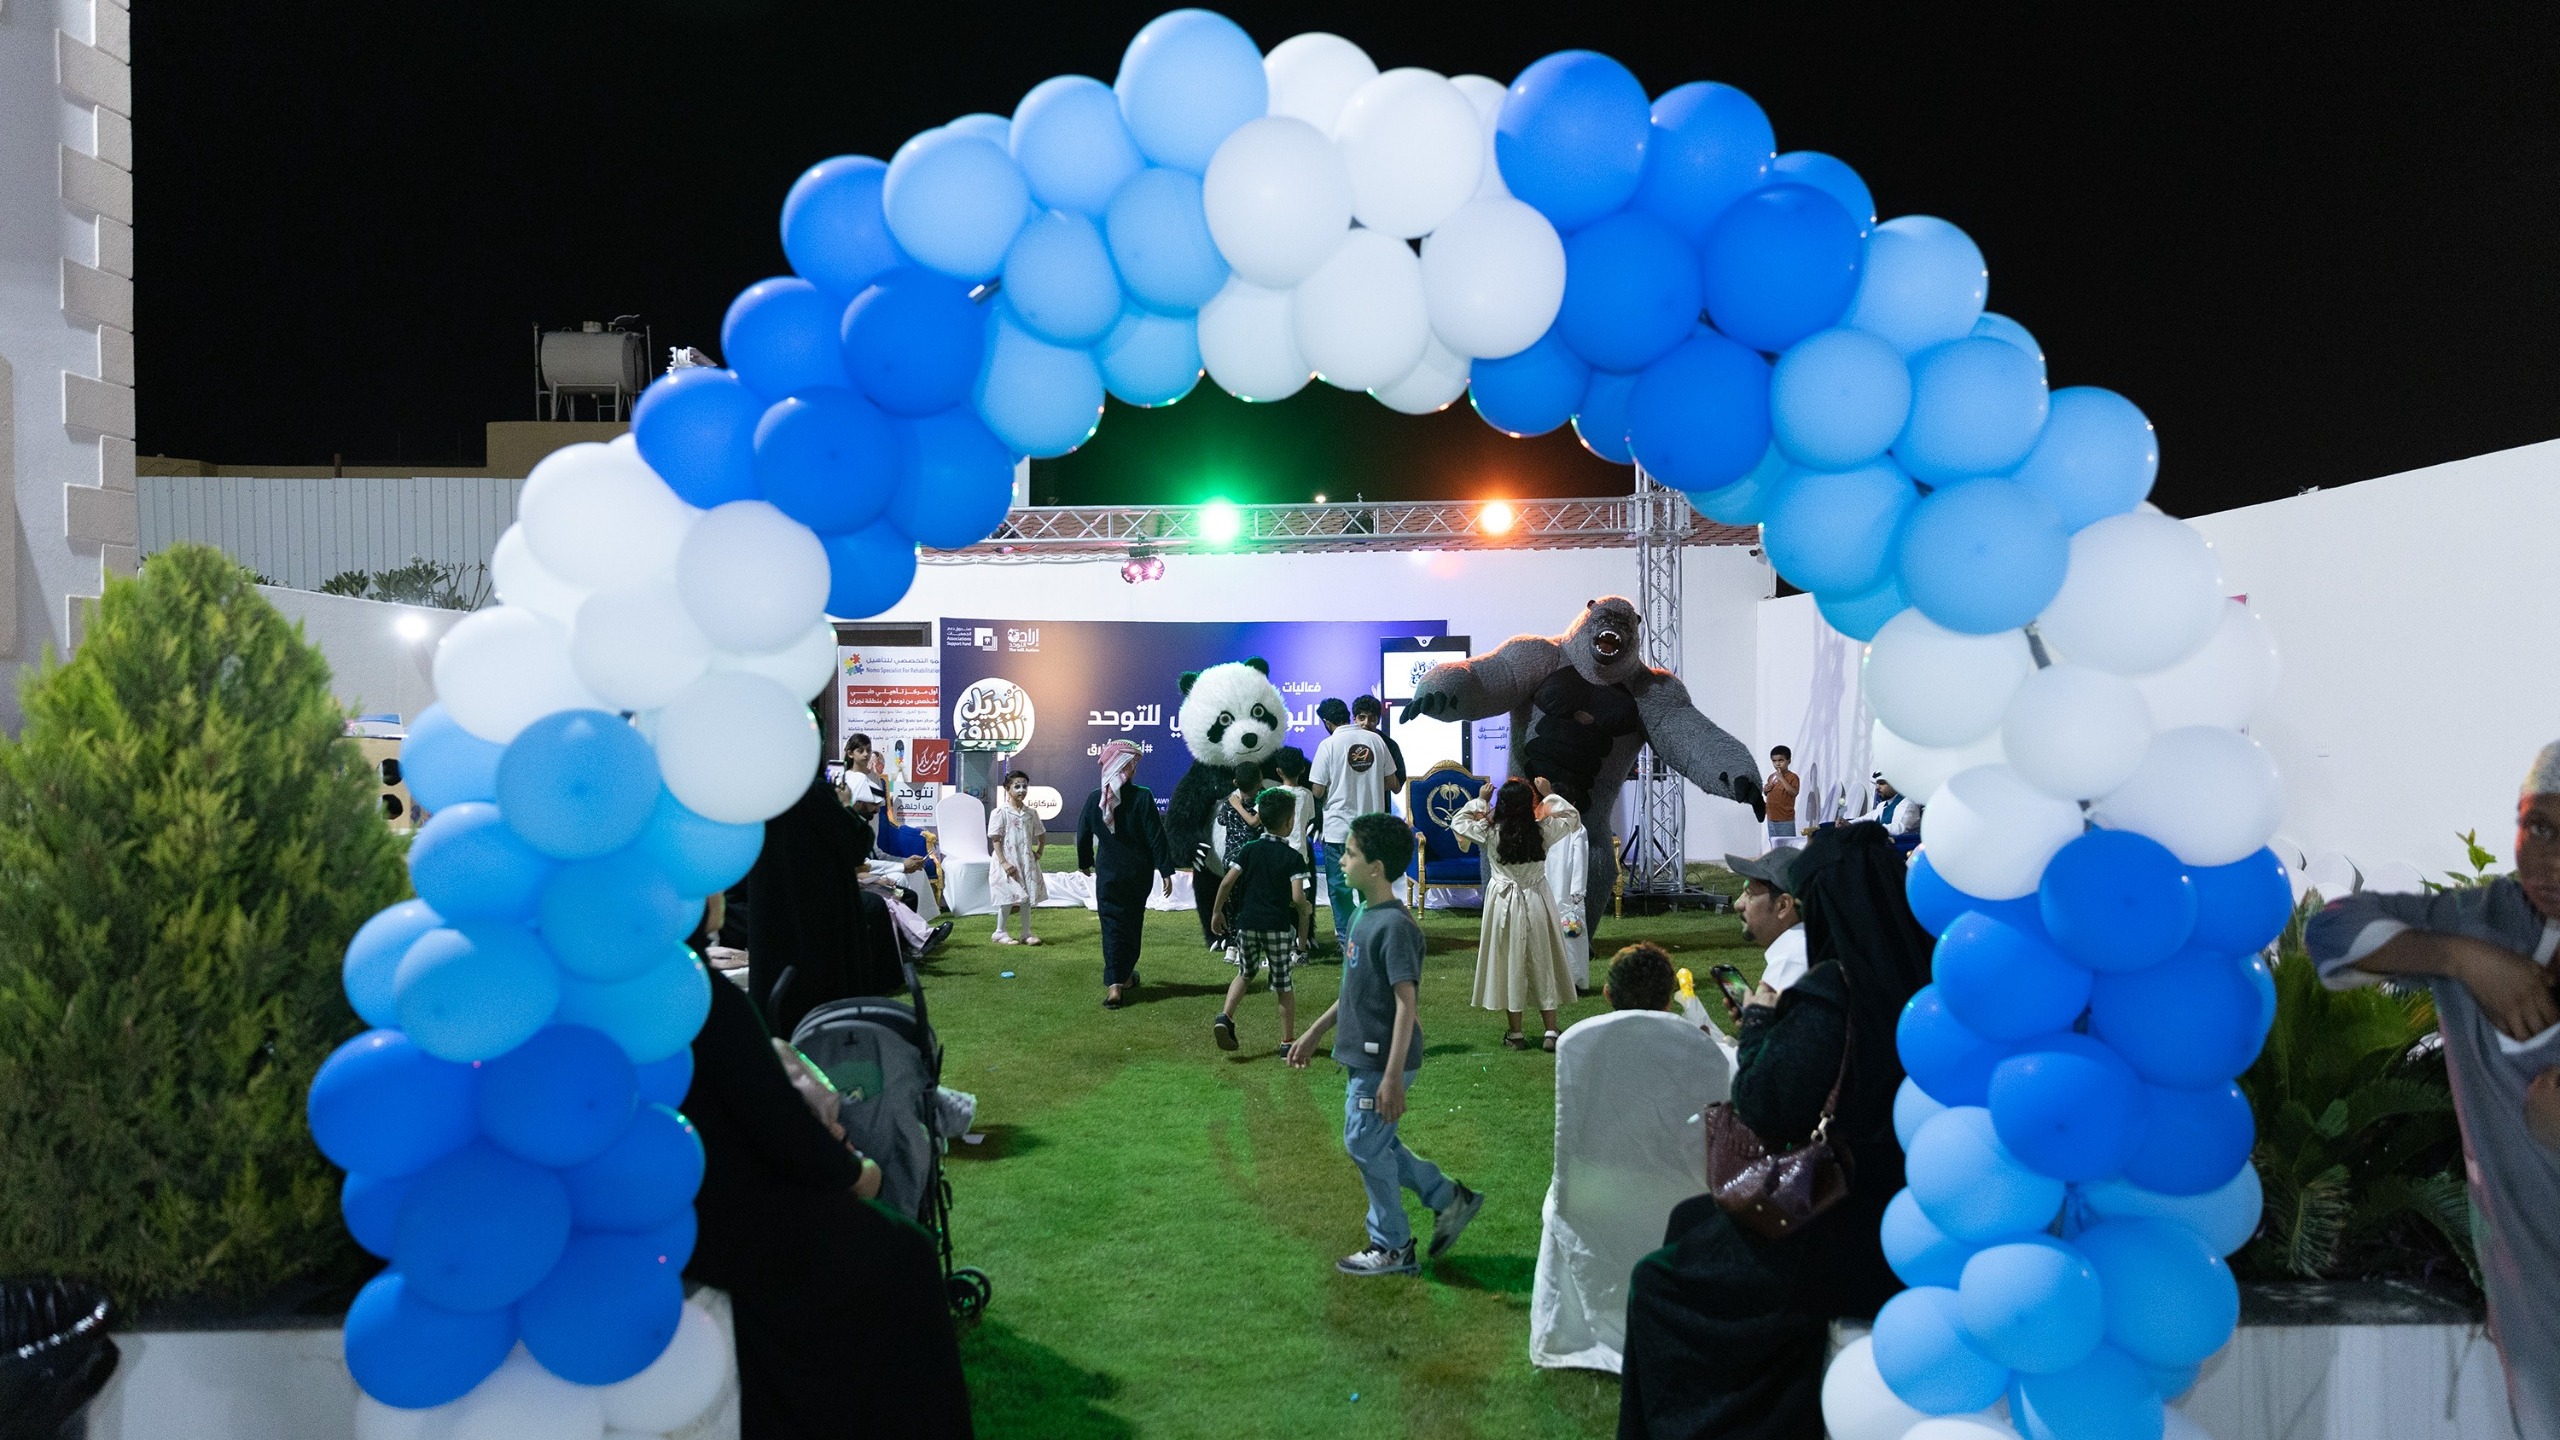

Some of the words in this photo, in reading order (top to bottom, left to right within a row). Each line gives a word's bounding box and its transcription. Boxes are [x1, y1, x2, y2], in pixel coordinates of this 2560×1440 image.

[1282, 681, 1321, 695] فعاليات
[849, 698, 864, 706] نجران
[1087, 704, 1161, 732] للتوحد
[1285, 704, 1321, 733] اليو
[897, 786, 934, 801] نتوحد
